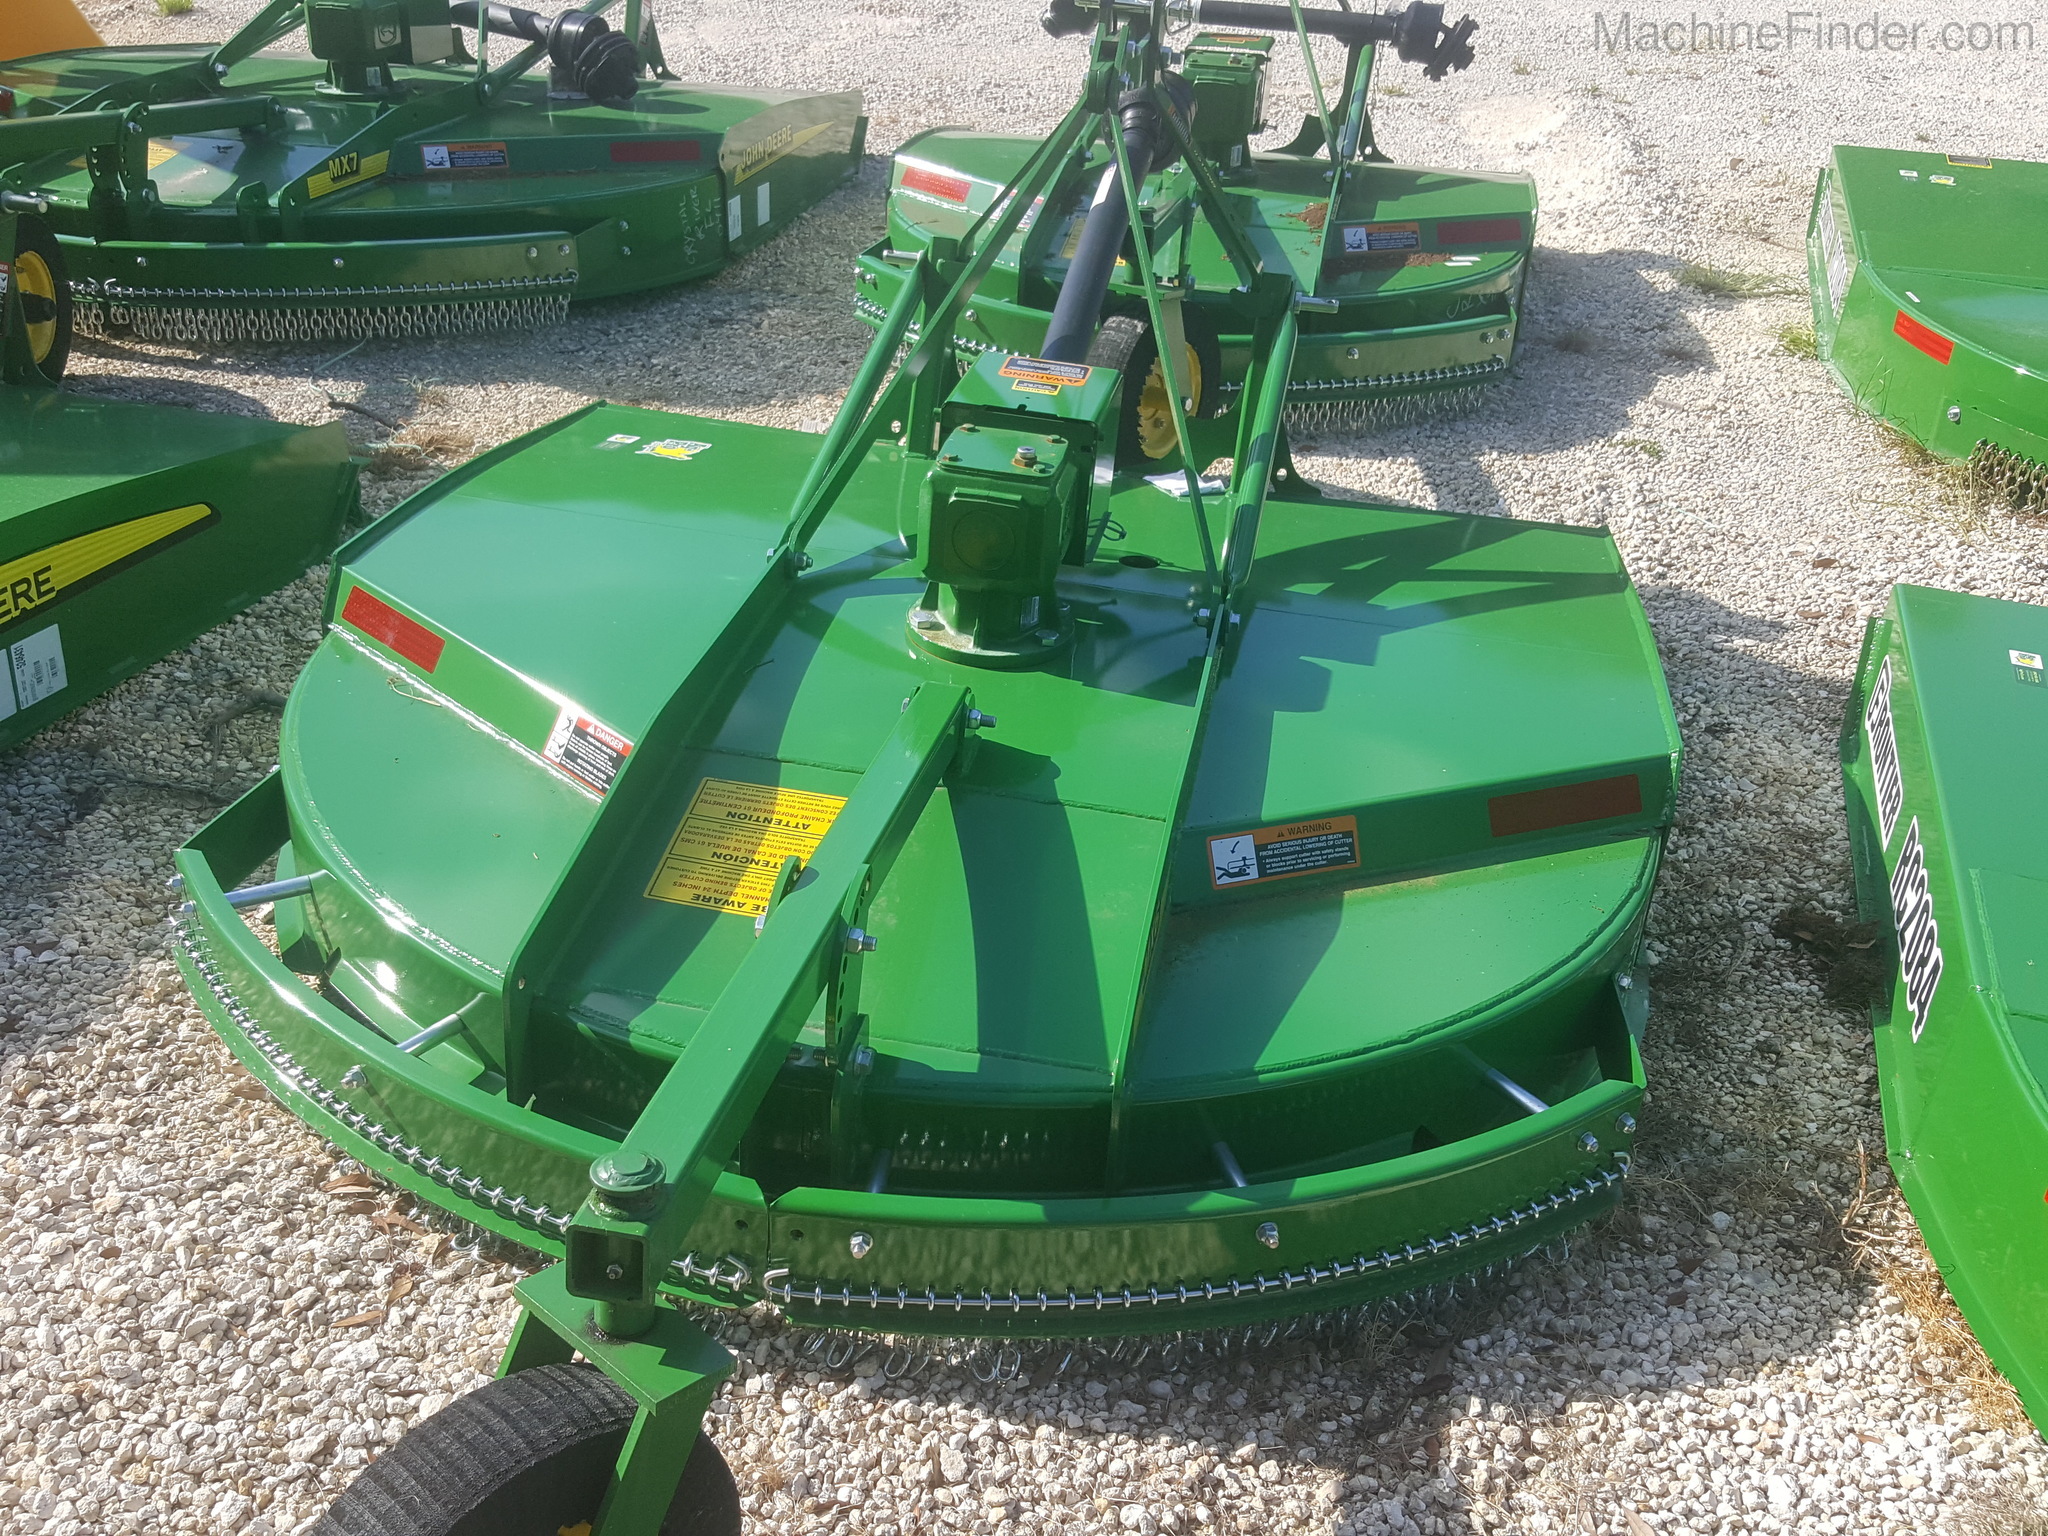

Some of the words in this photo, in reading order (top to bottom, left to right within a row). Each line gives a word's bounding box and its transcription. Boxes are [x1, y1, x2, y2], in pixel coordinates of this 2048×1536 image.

[741, 140, 764, 168] JOHN
[767, 124, 792, 152] DEERE
[328, 152, 359, 181] MX7
[690, 186, 705, 240] RIVER
[679, 195, 698, 265] CRYSTAL
[1003, 370, 1065, 382] WARNING
[595, 728, 623, 751] DANGER
[1867, 659, 1902, 848] FRONTIER
[725, 811, 810, 829] ATTENTION
[1287, 821, 1331, 836] WARNING
[671, 880, 701, 890] INCHES
[712, 888, 738, 896] DEPTH
[690, 893, 745, 908] AWARE
[739, 892, 770, 902] HANNEL
[1892, 823, 1941, 1040] RC2084
